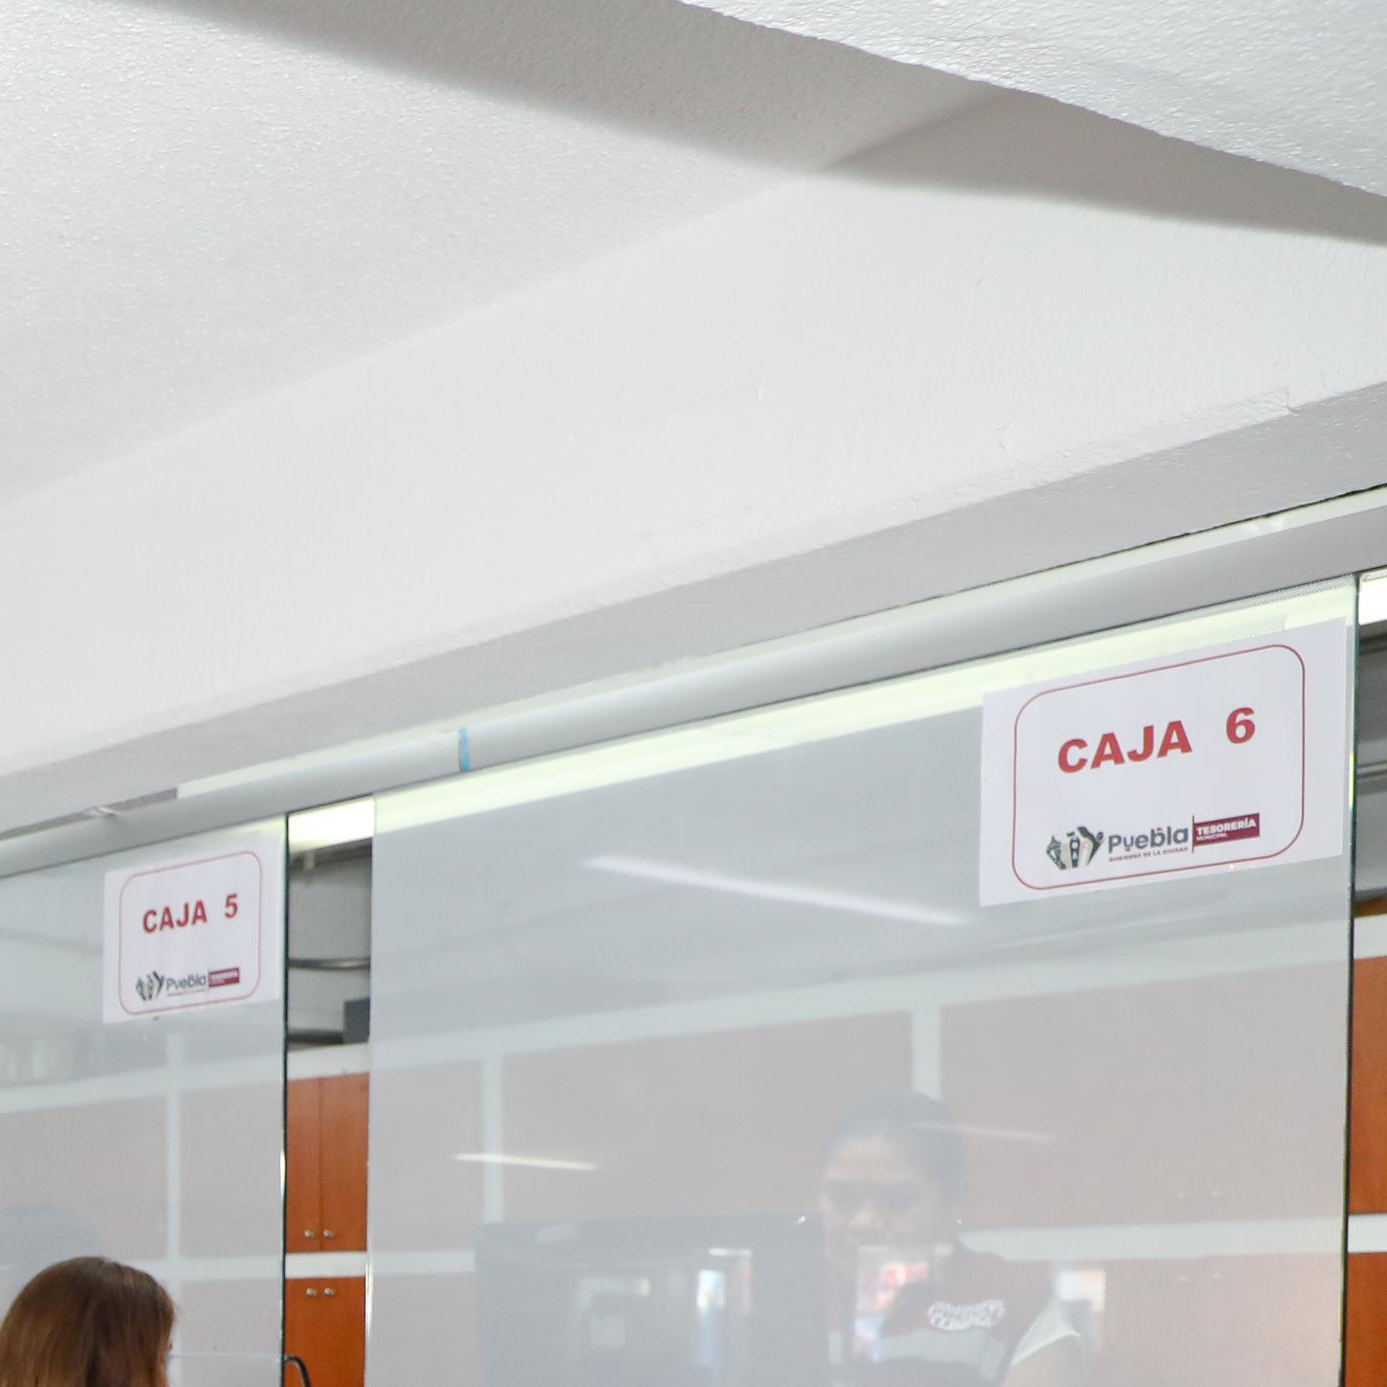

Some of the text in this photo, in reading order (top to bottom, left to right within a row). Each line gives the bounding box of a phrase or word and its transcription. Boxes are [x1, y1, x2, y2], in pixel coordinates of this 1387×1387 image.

[1057, 707, 1256, 774] CAJA 6
[1108, 826, 1189, 854] Puebla
[1196, 817, 1257, 836] TESORERÍA
[142, 893, 239, 934] CAJA 5
